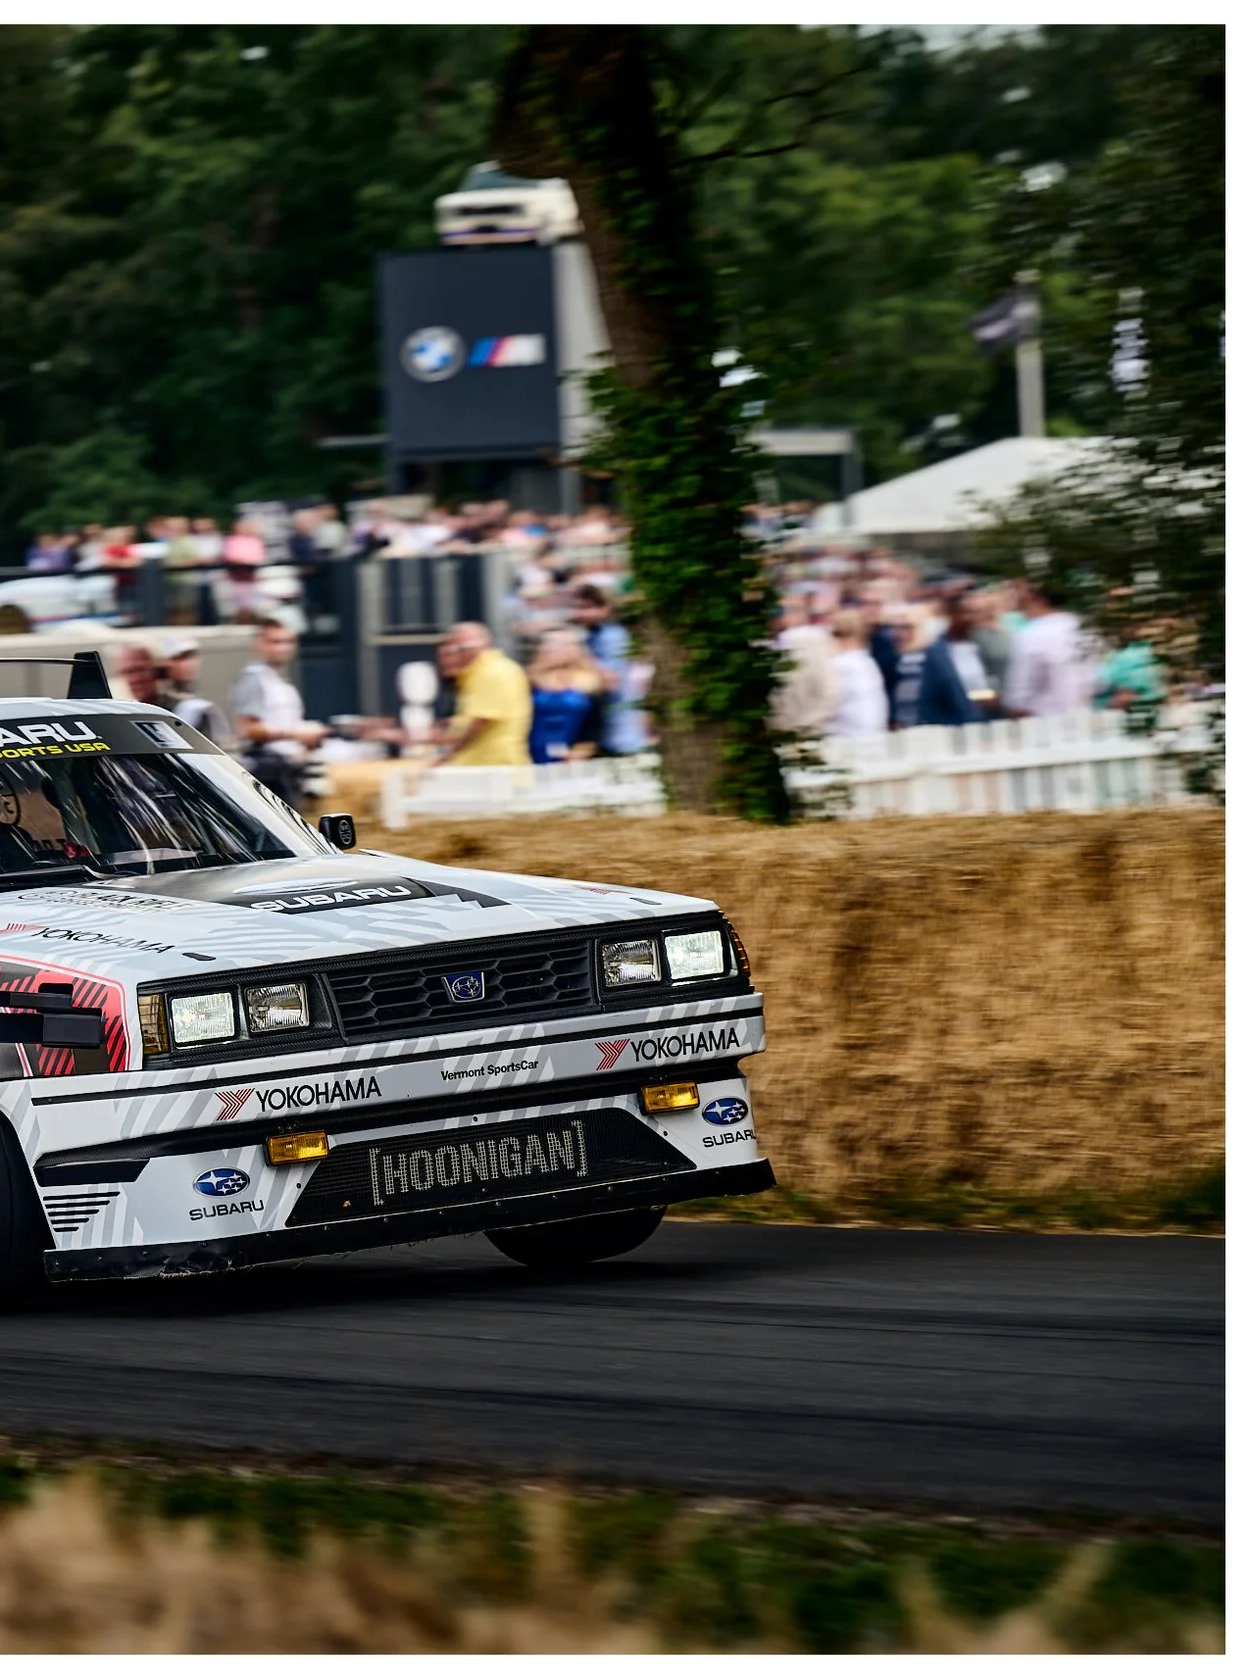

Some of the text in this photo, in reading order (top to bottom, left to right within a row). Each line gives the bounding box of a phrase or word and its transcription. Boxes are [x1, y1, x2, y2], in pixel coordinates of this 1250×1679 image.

[65, 741, 111, 753] USA
[251, 885, 411, 912] SUBARU
[31, 927, 175, 954] YOKOHAMA
[631, 1028, 741, 1063] YOKOHAMA
[441, 1059, 539, 1082] Vermont SportsCar
[256, 1075, 382, 1113] YOKOHAMA
[189, 1199, 265, 1221] SUBARU
